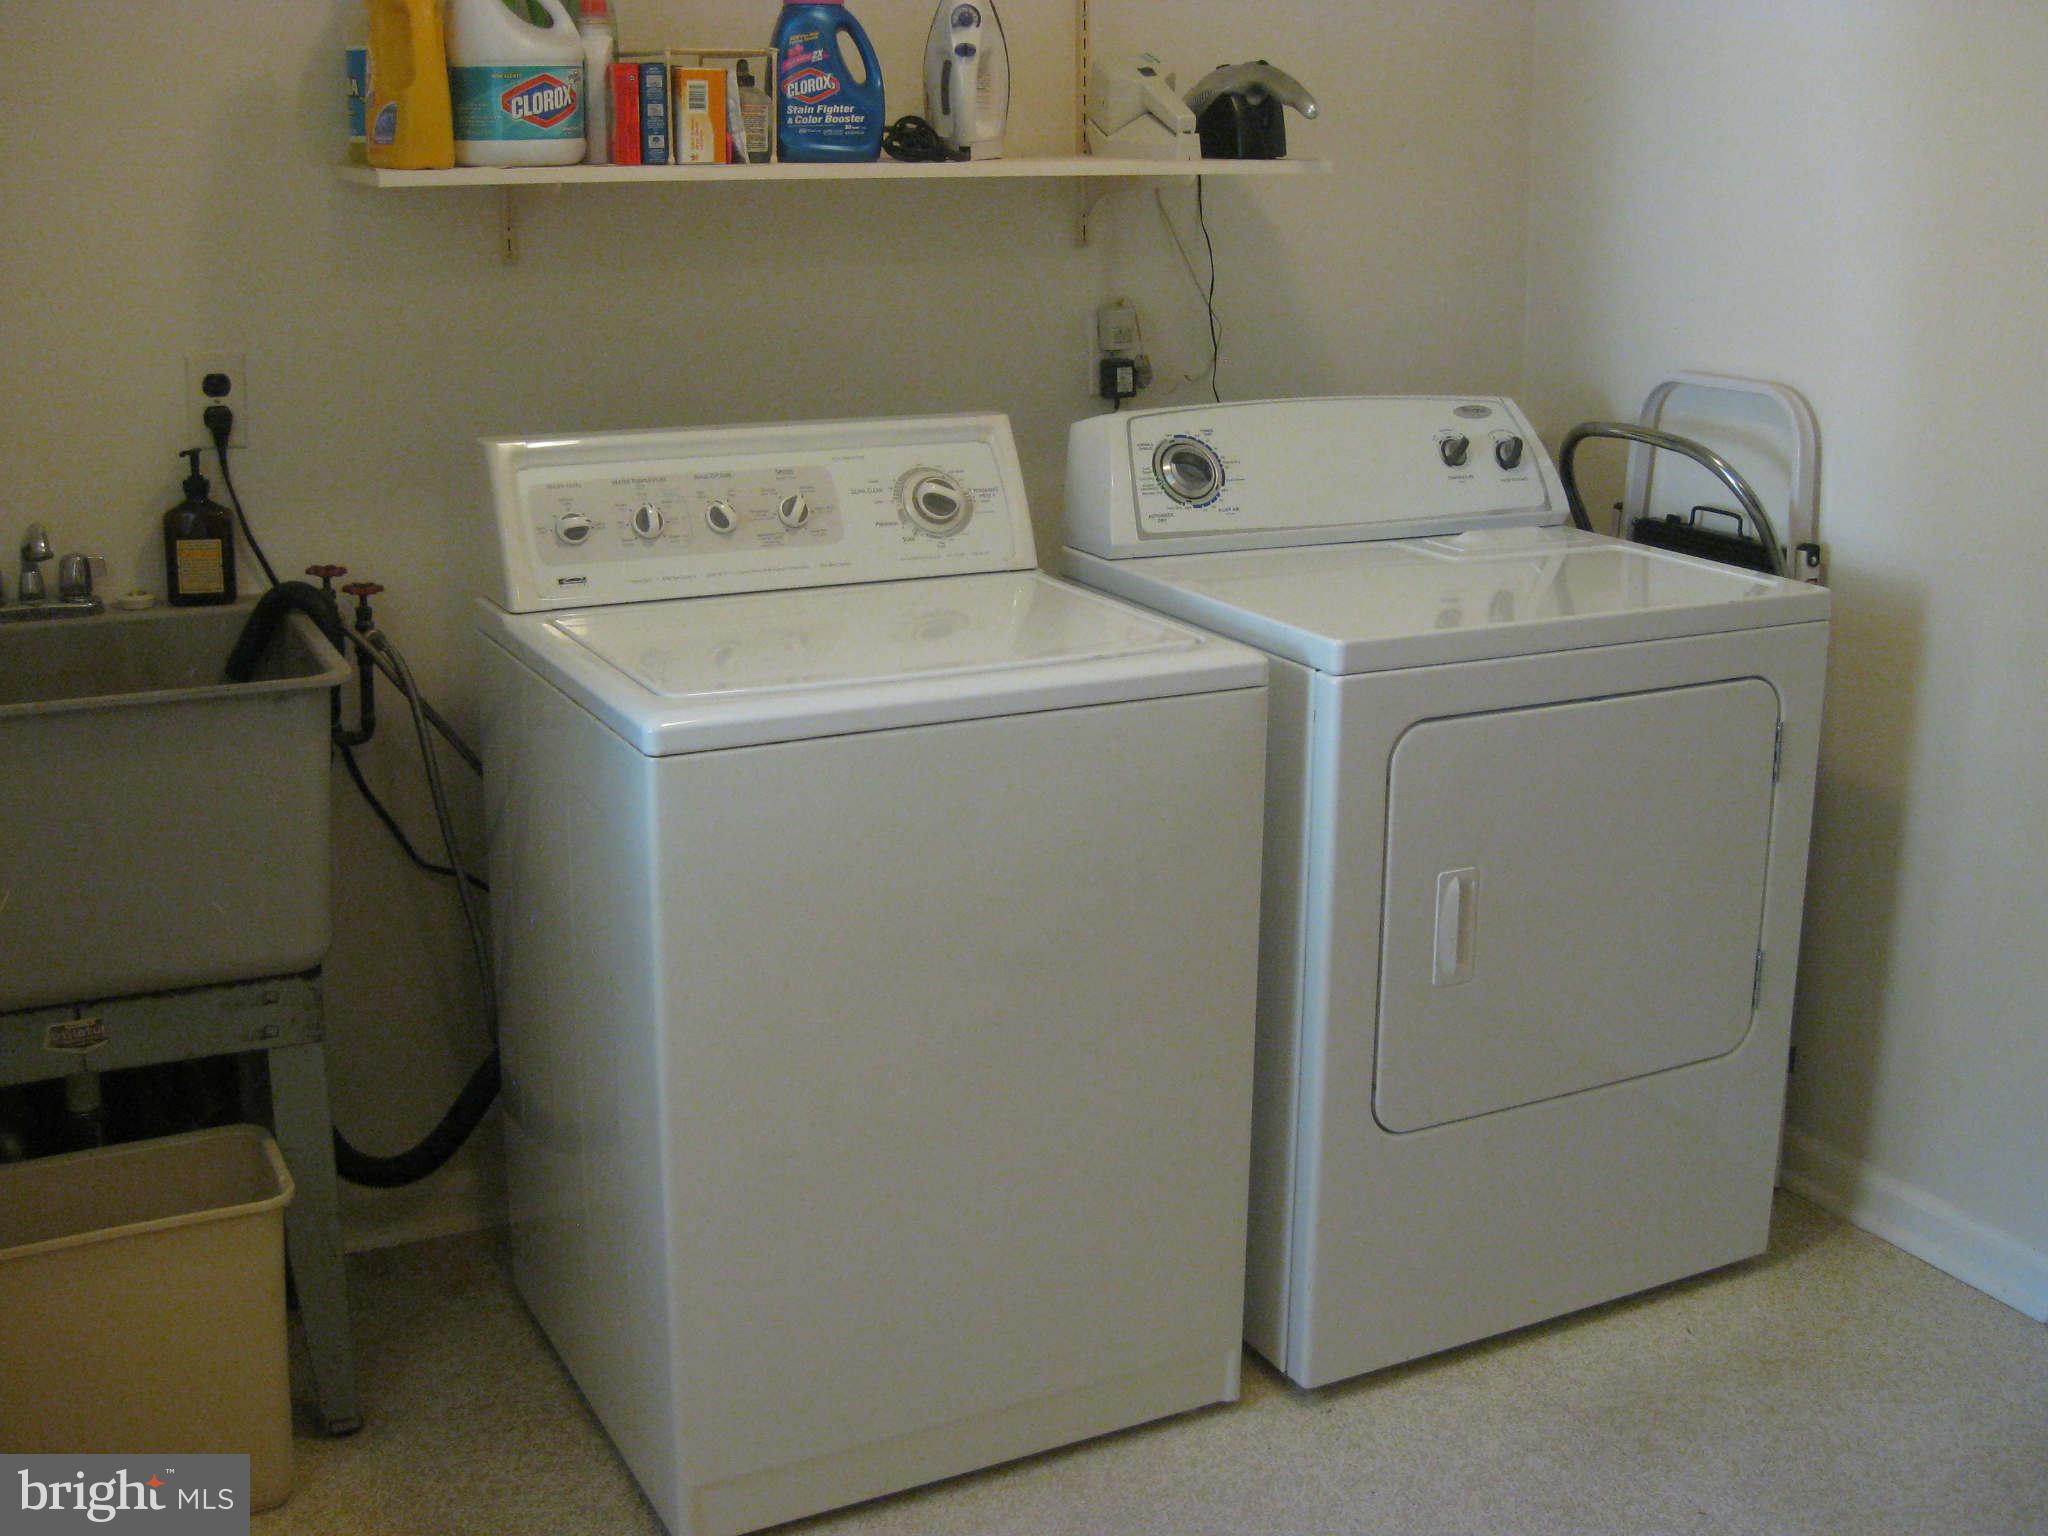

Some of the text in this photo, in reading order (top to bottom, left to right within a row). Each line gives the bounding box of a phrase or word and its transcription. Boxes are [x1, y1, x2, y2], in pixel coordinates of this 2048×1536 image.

[511, 85, 572, 119] CLOROX
[787, 104, 855, 115] Stain Fighter
[794, 115, 822, 124] Color
[824, 114, 865, 123] Booster
